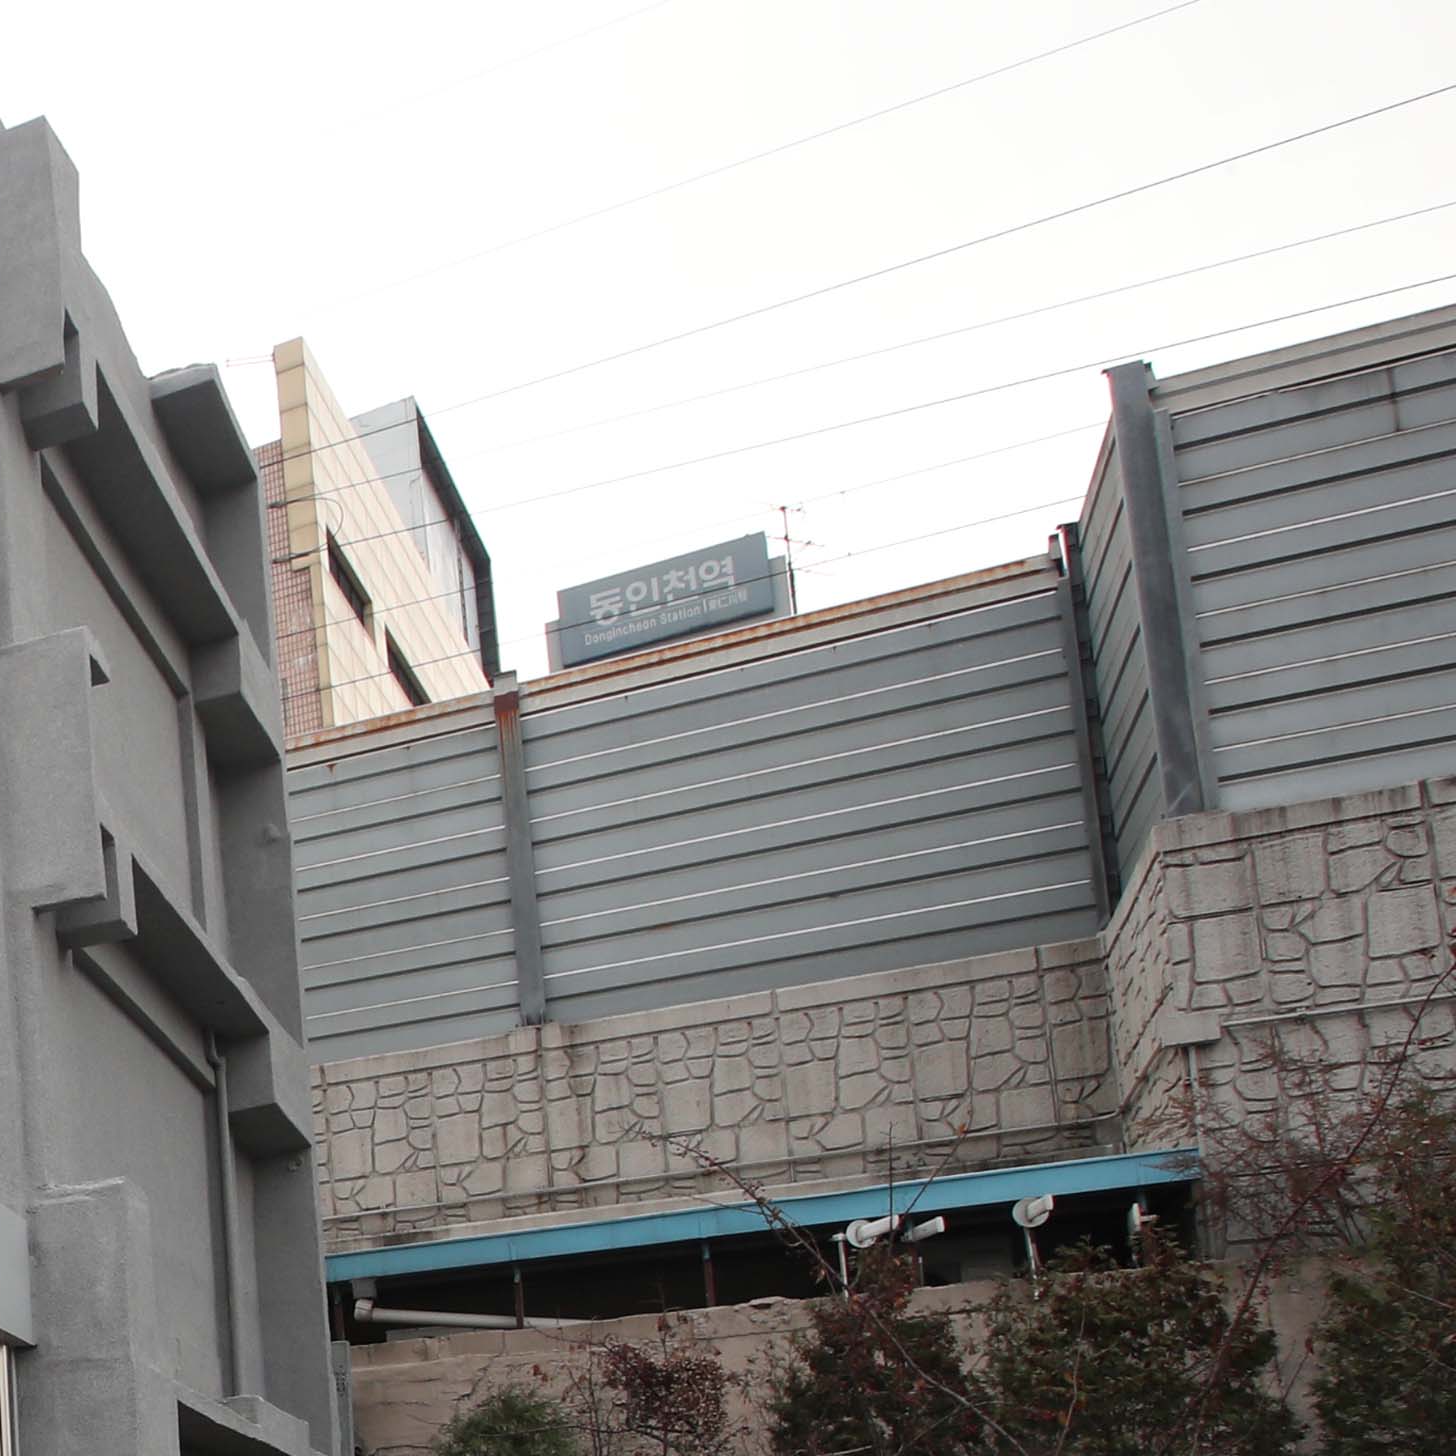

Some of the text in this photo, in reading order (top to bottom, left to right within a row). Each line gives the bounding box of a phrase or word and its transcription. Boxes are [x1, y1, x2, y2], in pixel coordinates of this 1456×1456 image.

[590, 555, 737, 626] 동인천역
[584, 618, 657, 646] Dongincheon
[661, 605, 701, 625] Station
